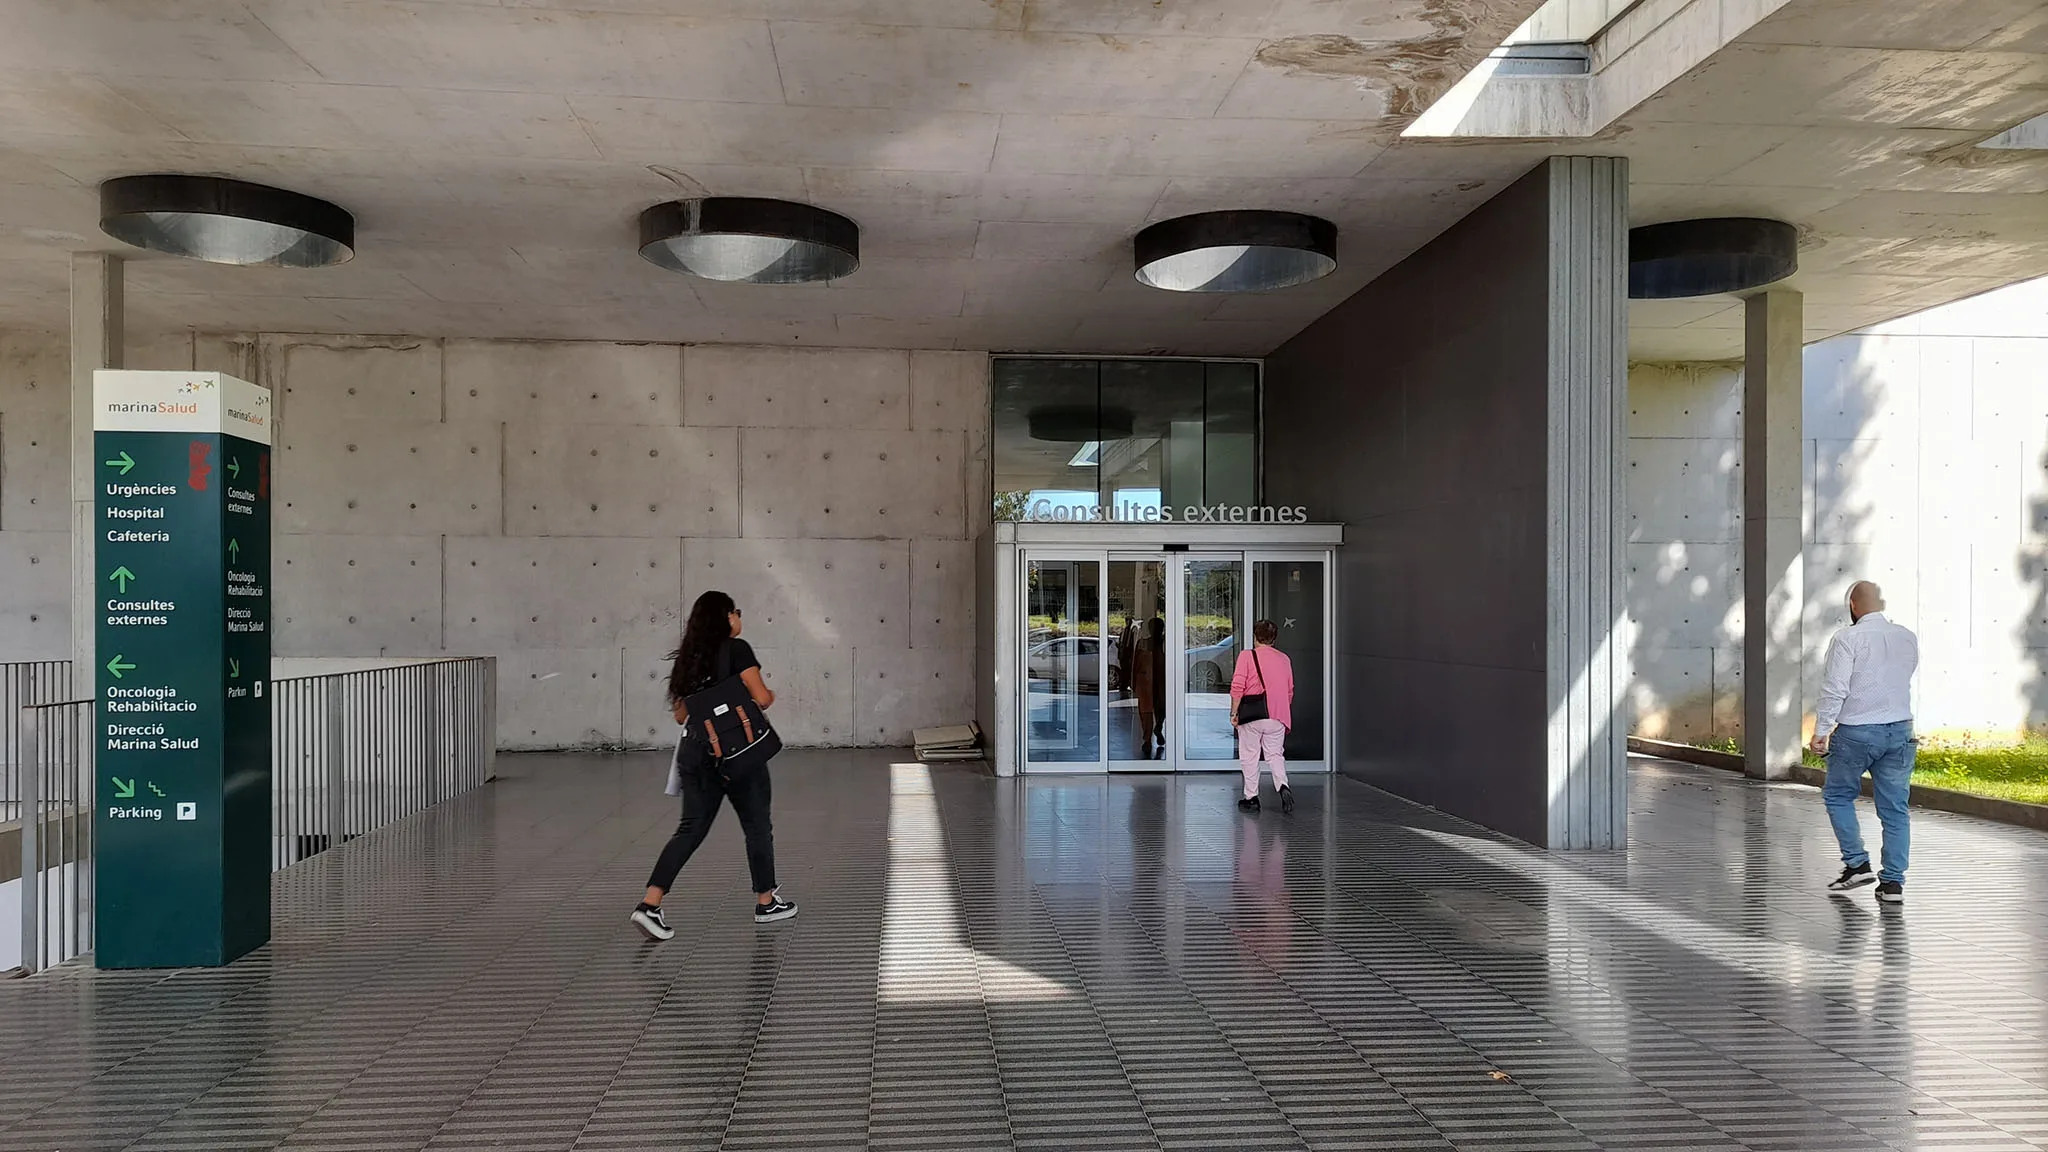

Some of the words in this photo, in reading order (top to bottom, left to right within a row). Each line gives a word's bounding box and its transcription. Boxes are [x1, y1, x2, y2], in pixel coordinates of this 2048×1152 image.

[108, 402, 197, 414] marinaSalud
[106, 483, 177, 498] Urgències
[228, 486, 256, 501] Consultes
[107, 506, 164, 521] Hospital
[228, 503, 253, 515] externes
[1032, 498, 1174, 523] Consultes
[1183, 502, 1308, 523] externes
[107, 530, 170, 542] Cafeteria
[227, 570, 256, 585] Oncologia
[107, 599, 175, 611] Consultes
[107, 615, 168, 626] externes
[227, 621, 248, 633] Marina
[249, 621, 264, 632] Salud
[107, 685, 177, 700] Oncologia
[107, 723, 165, 736] Direcció
[107, 738, 157, 750] Marina
[160, 737, 199, 749] Salud
[109, 806, 162, 821] Pàrking
